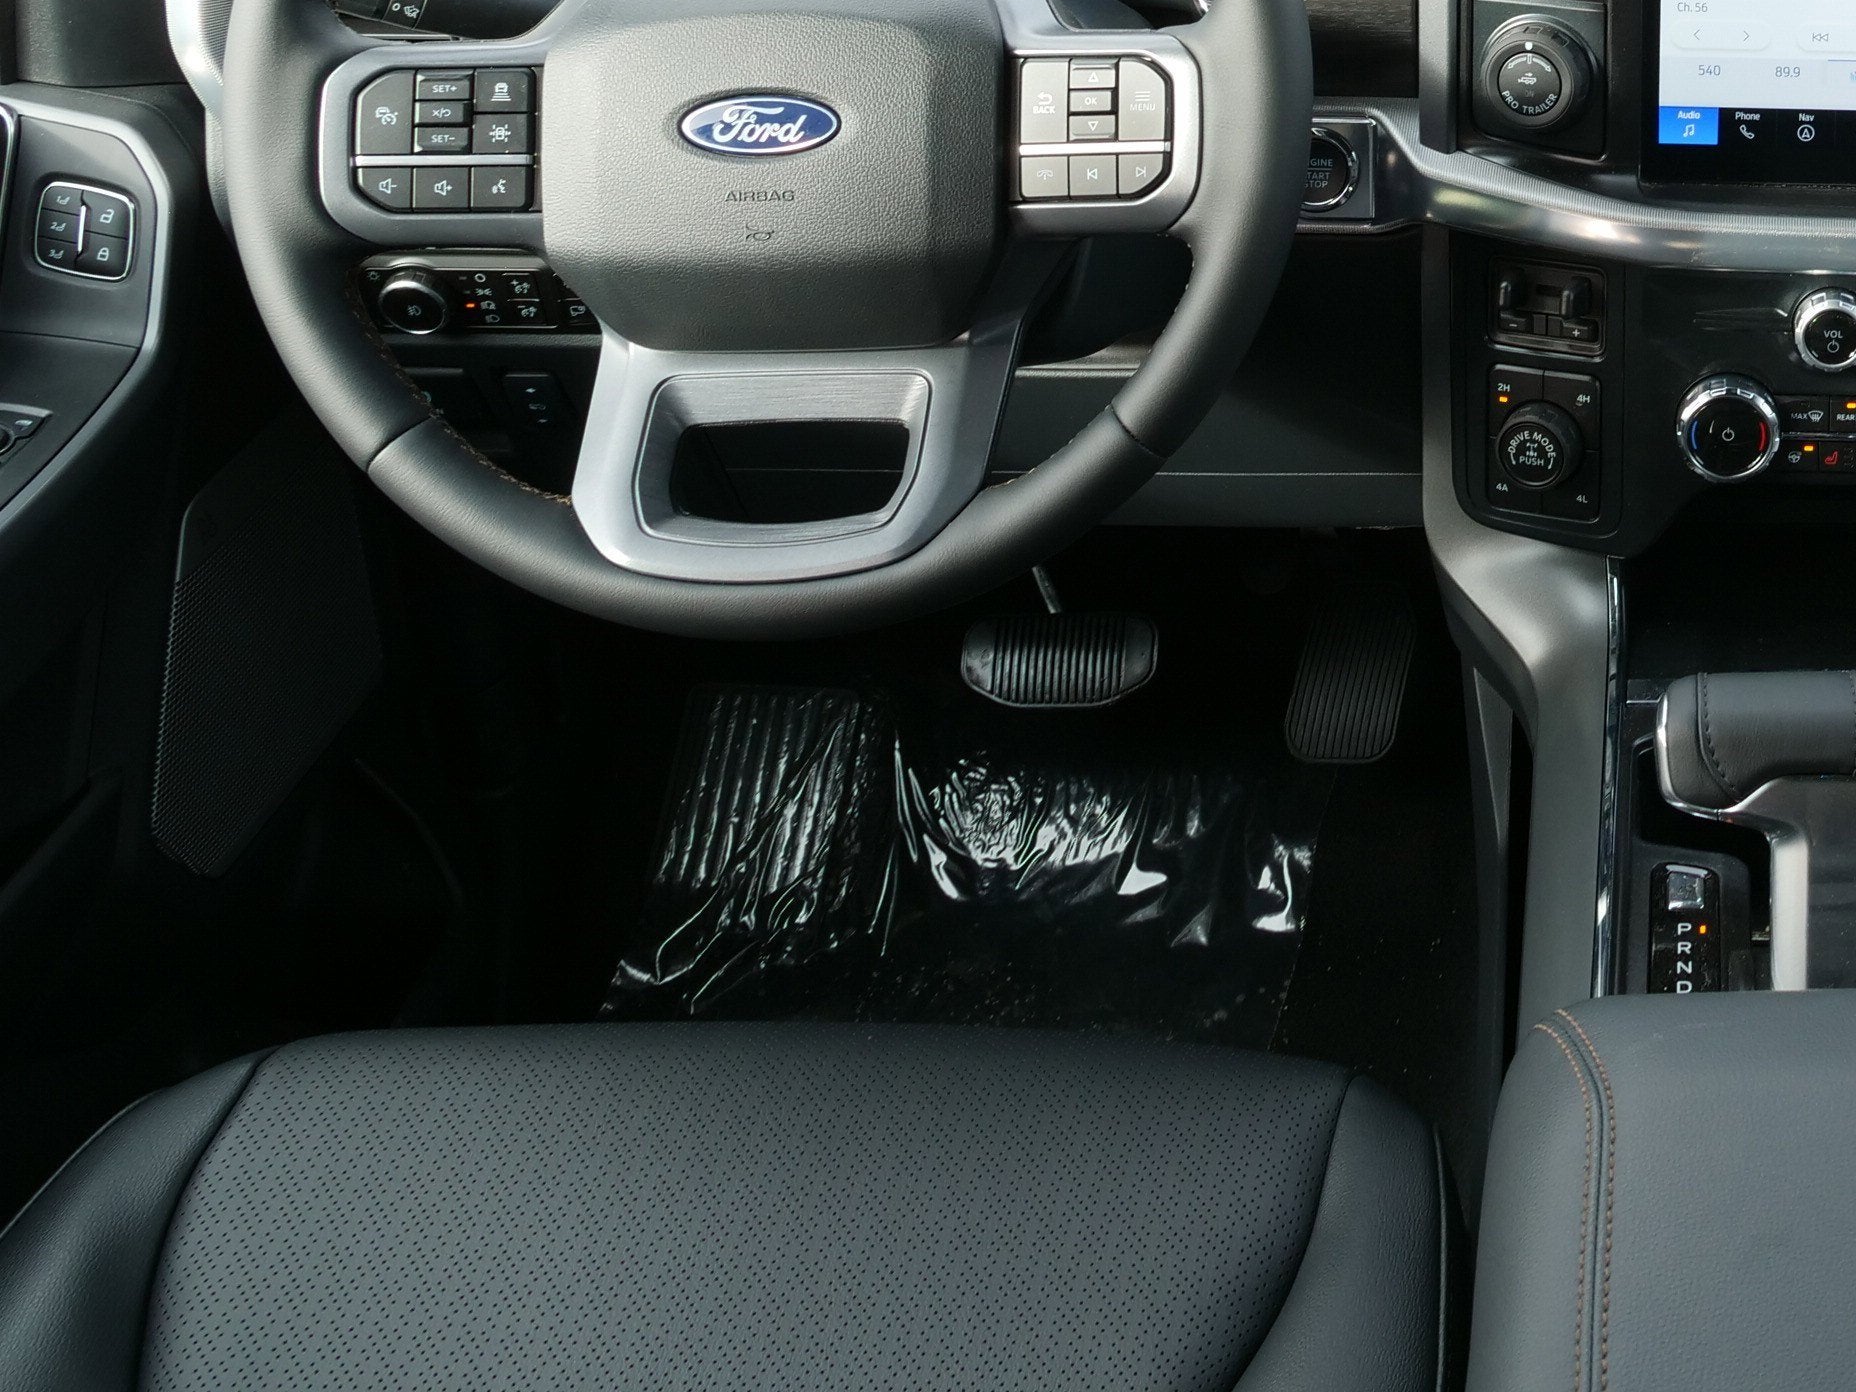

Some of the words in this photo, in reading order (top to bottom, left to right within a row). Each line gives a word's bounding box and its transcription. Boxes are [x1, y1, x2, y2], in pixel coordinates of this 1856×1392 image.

[1677, 2, 1693, 13] Ch.
[1694, 2, 1708, 13] 56
[1698, 64, 1721, 77] 540
[1774, 66, 1801, 78] 89.9
[432, 84, 458, 94] SET+
[1084, 96, 1097, 105] OK
[1501, 90, 1519, 110] PRO
[1522, 93, 1558, 114] TRAILER
[1032, 106, 1055, 114] BACK
[1130, 102, 1156, 111] MENU
[1678, 110, 1701, 120] Audio
[1735, 112, 1760, 121] Phone
[1798, 113, 1815, 122] Nav
[712, 105, 807, 143] Ford
[431, 134, 455, 143] SET-
[1308, 158, 1333, 167] GINE
[1306, 172, 1330, 180] TART
[725, 190, 795, 203] AIRBAG
[1822, 330, 1843, 339] VOL
[1498, 383, 1511, 392] 2H
[1576, 394, 1591, 404] 4H
[1790, 412, 1809, 421] MAX
[1836, 414, 1855, 422] REAR
[1507, 430, 1531, 454] DRIVE
[1532, 432, 1557, 458] MODE
[1519, 456, 1545, 466] PUSH
[1496, 483, 1509, 492] 4A
[1576, 494, 1588, 504] 4L
[1678, 922, 1692, 935] P
[1677, 942, 1692, 955] R
[1676, 961, 1693, 974] N
[1676, 980, 1693, 994] D
